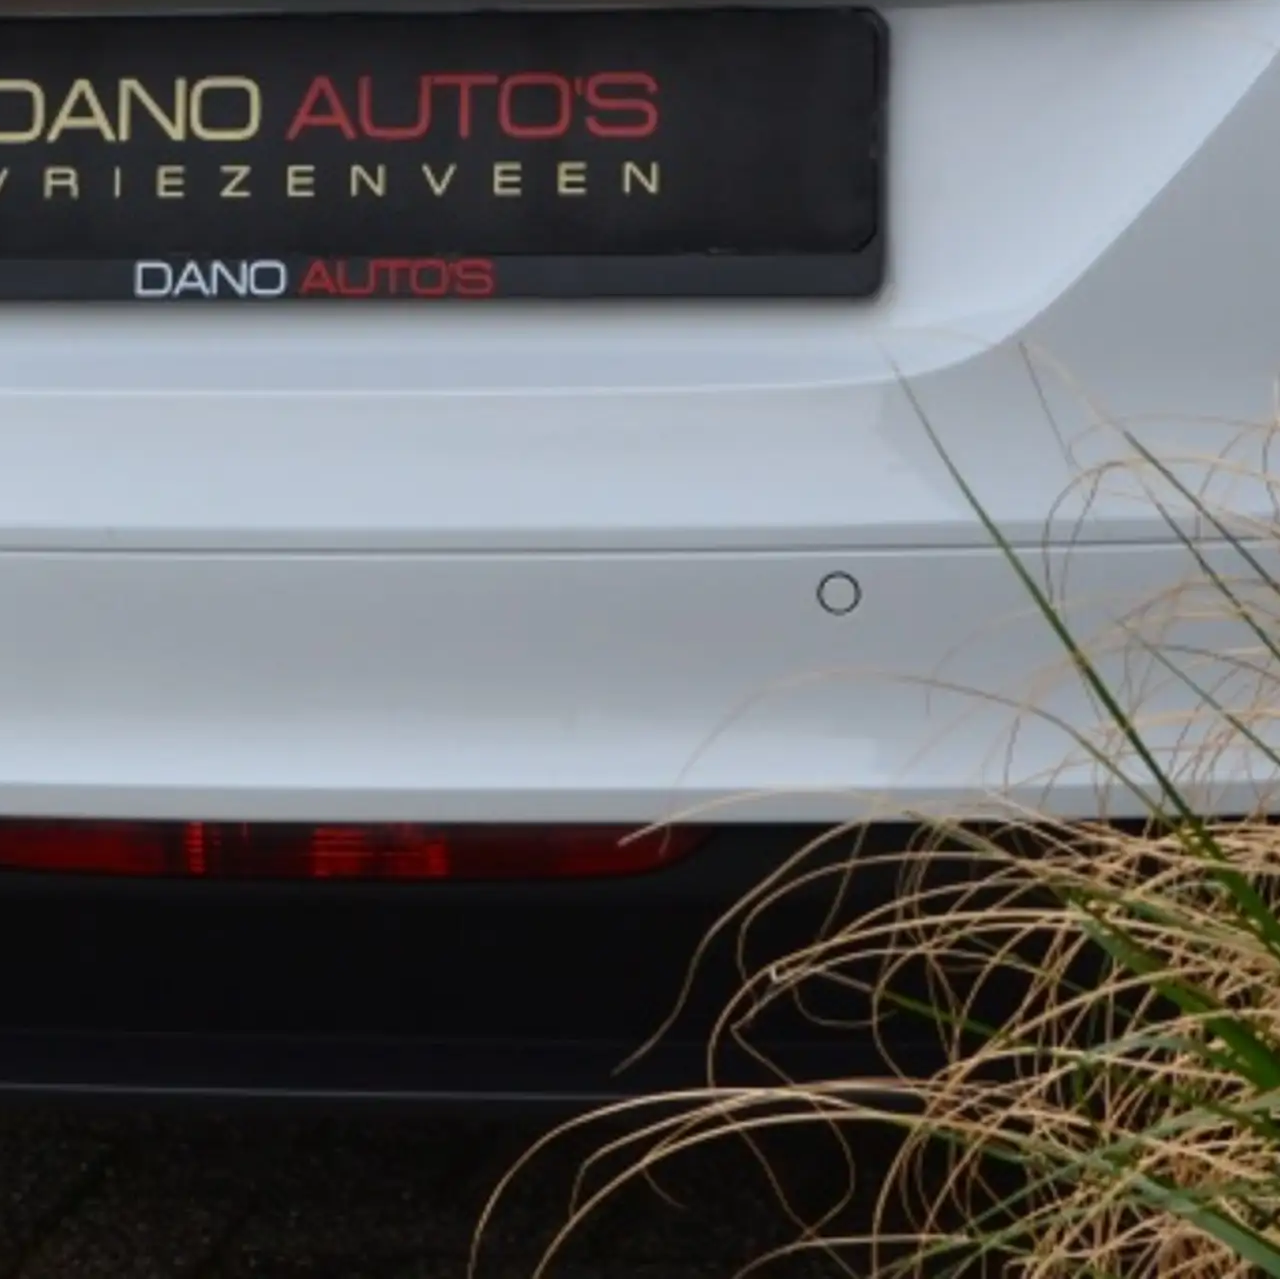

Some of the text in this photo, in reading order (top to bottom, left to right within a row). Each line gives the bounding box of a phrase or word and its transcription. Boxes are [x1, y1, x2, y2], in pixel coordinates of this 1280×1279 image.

[285, 71, 659, 141] AUTO'S
[134, 258, 495, 298] DANO AUTO'S
